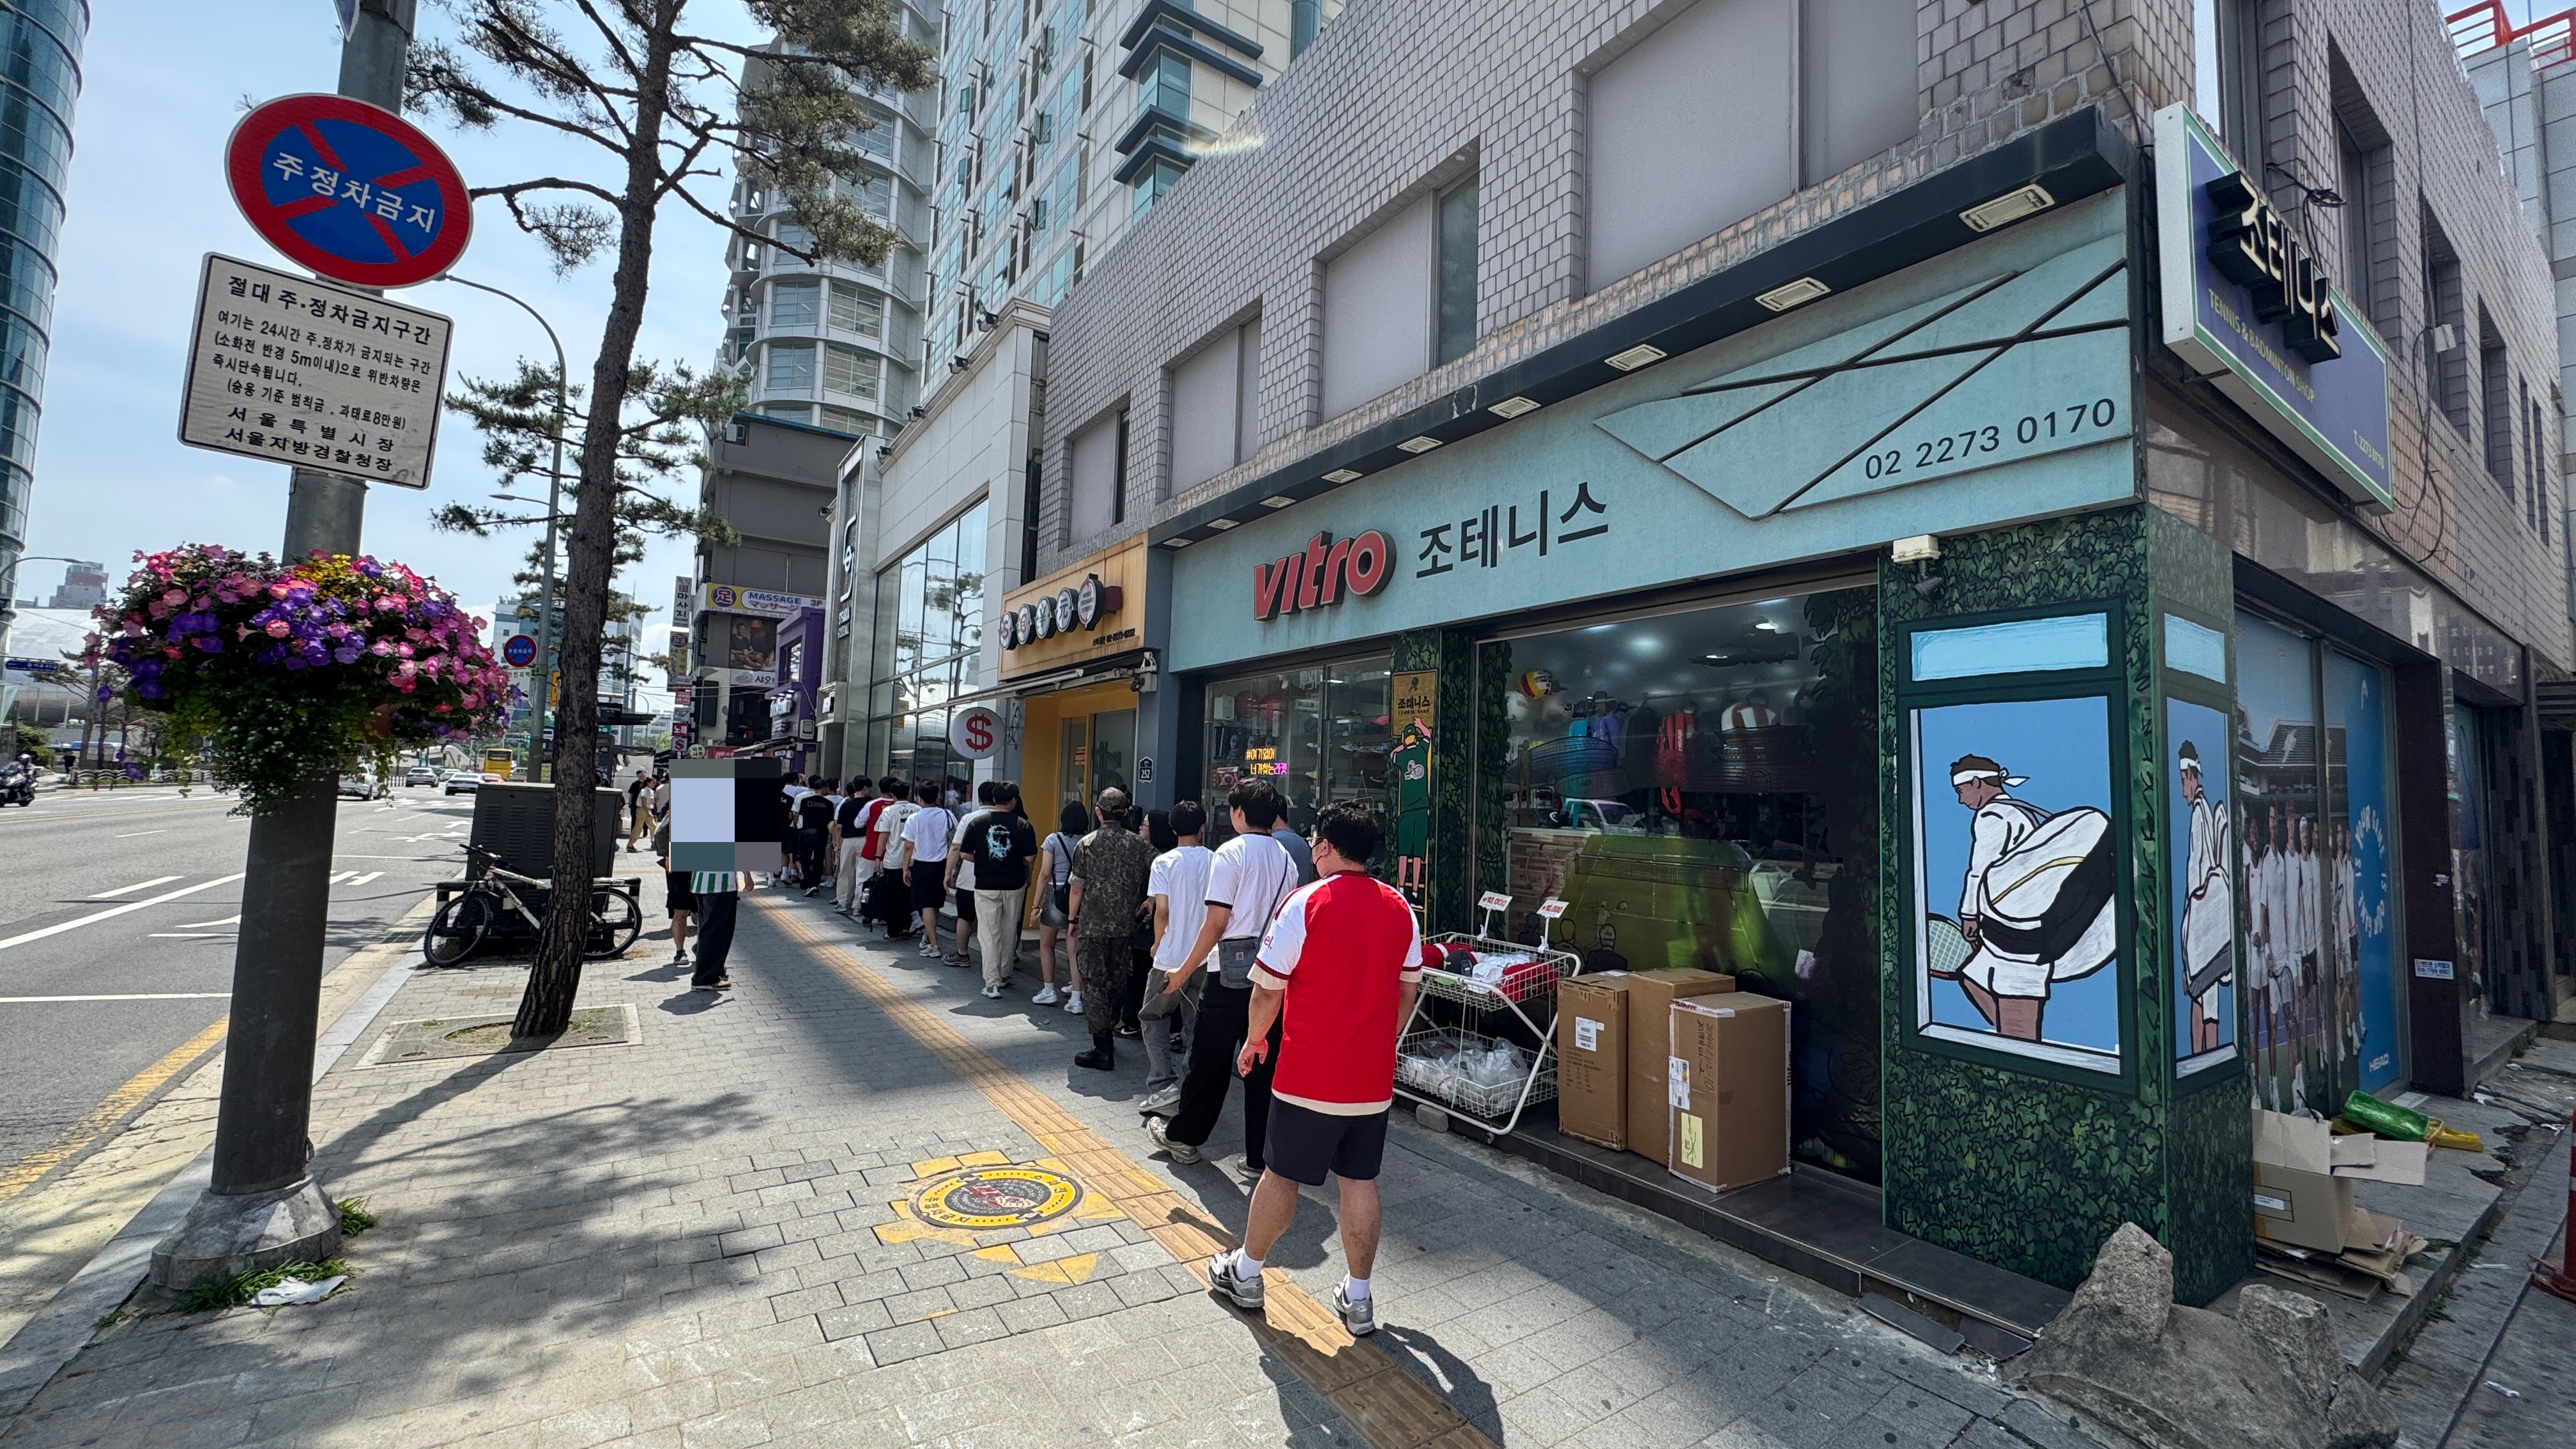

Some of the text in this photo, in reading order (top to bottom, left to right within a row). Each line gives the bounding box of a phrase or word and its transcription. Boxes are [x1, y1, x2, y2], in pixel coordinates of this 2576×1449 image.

[273, 152, 435, 233] 주정차금지
[2238, 172, 2340, 356] 조테니스
[228, 275, 270, 303] 절대
[215, 331, 420, 394] (소화전 반경 5m이내)으로 위반차량은
[218, 310, 254, 331] 여기는
[260, 320, 301, 342] 24시간
[361, 346, 404, 368] 금지되는
[410, 358, 431, 376] 구간
[2209, 288, 2315, 403] TENNIS & BADMINTON SHOP
[213, 353, 302, 387] 즉시단속됩니다.
[227, 378, 256, 397] (승용
[261, 388, 285, 404] 기준
[291, 392, 325, 413] 범칙금
[224, 427, 392, 471] 서울지방경찰청장
[1866, 398, 2115, 480] 02 2273 0170
[1416, 481, 1609, 579] 조테니스
[1254, 529, 1393, 621] vitro
[676, 593, 689, 618] 마사지
[748, 592, 802, 605] MASSAGE
[1397, 695, 1430, 709] 조테니스
[965, 713, 994, 753] $
[1140, 769, 1151, 779] 252
[2369, 1053, 2389, 1073] HEAD
